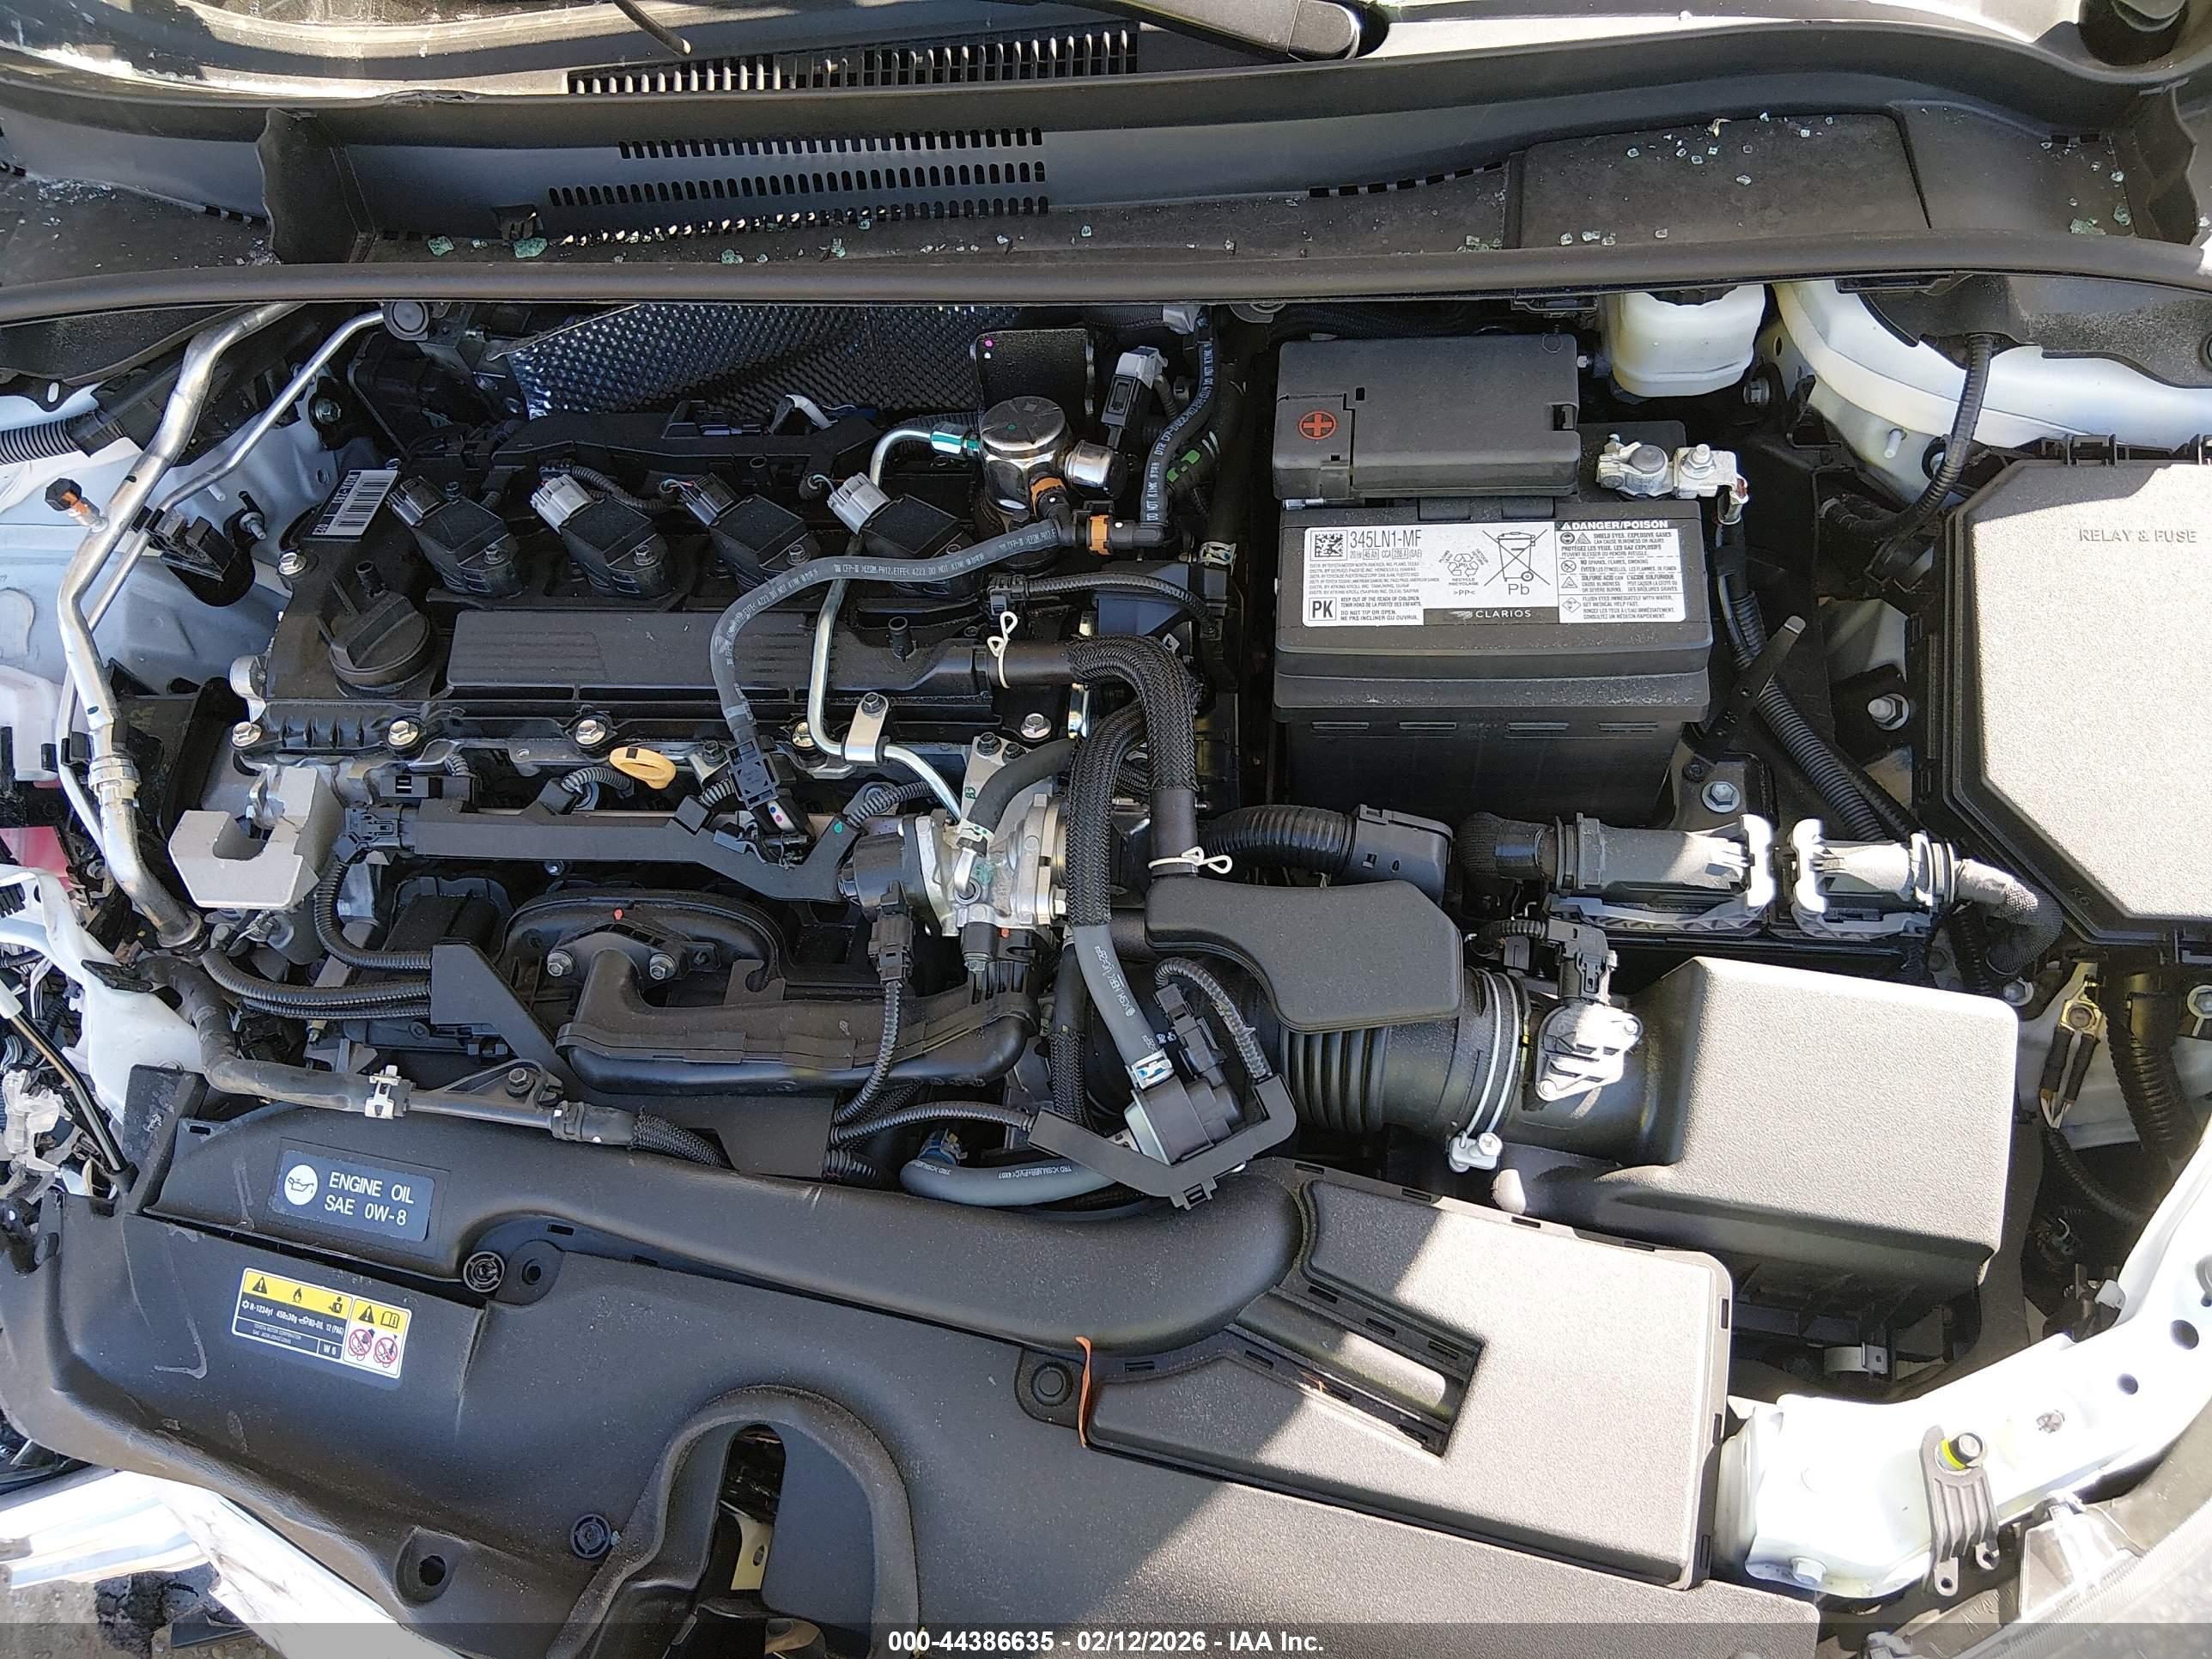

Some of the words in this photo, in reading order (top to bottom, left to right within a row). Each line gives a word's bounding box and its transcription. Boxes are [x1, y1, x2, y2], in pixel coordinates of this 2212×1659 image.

[1147, 481, 1159, 497] KINK
[1146, 496, 1159, 511] NOT
[1146, 511, 1159, 522] DO
[1572, 520, 1668, 531] DANGER/POISON
[1350, 530, 1422, 548] 345LN1-MF
[2079, 528, 2133, 542] RELAY
[2138, 530, 2149, 542] &
[2154, 529, 2197, 543] FUSE
[1509, 584, 1529, 595] Pb
[1312, 600, 1333, 618] PK
[1475, 610, 1531, 618] CLARIOS
[329, 1171, 383, 1197] ENGINE
[391, 1184, 414, 1204] OIL
[325, 1194, 356, 1215] SAE
[364, 1202, 407, 1226] 0W-8
[323, 1345, 331, 1353] W
[332, 1346, 337, 1355] 6
